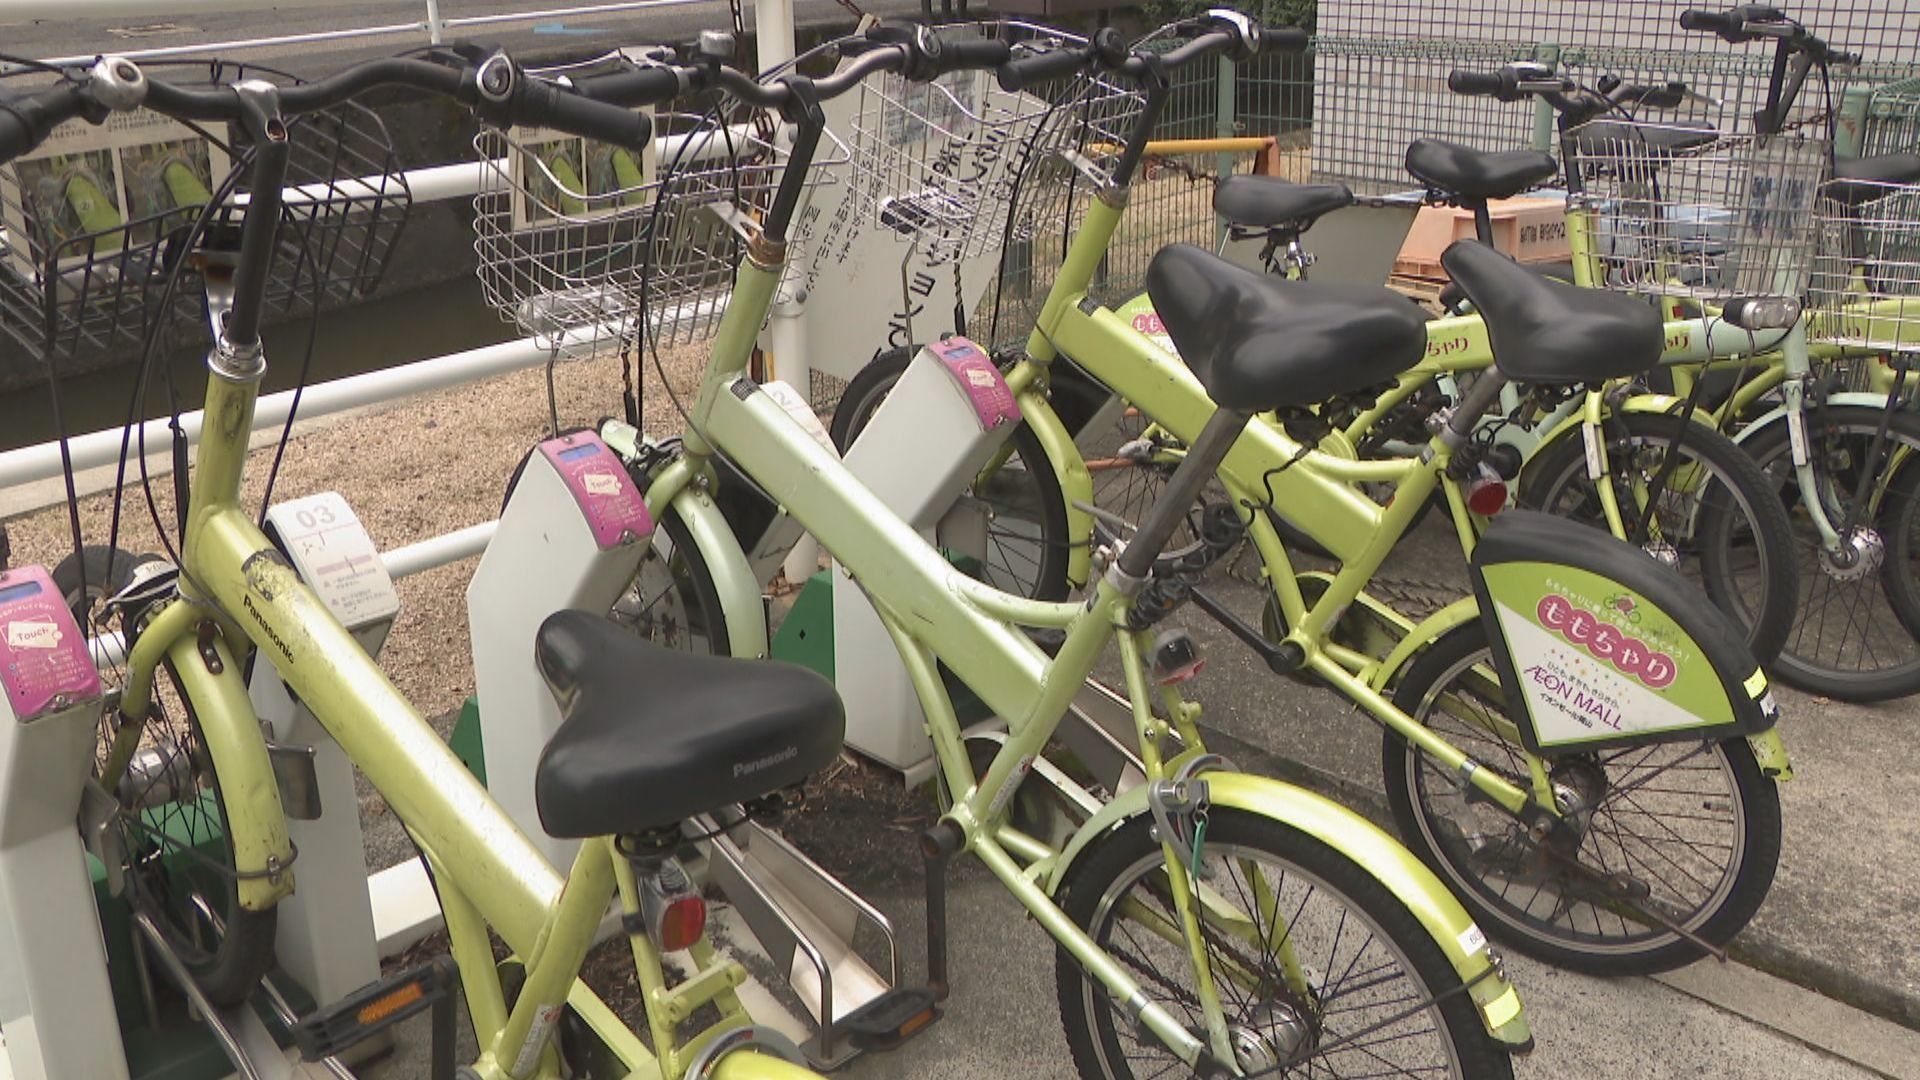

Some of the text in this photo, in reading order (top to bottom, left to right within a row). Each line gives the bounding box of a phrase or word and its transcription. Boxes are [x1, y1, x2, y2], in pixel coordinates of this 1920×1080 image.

[296, 505, 336, 528] 03
[16, 627, 49, 642] Touch
[243, 594, 295, 664] Panasonic
[1545, 601, 1669, 682] ももちゃり
[1573, 692, 1623, 730] MALL
[733, 746, 799, 778] Panasonic
